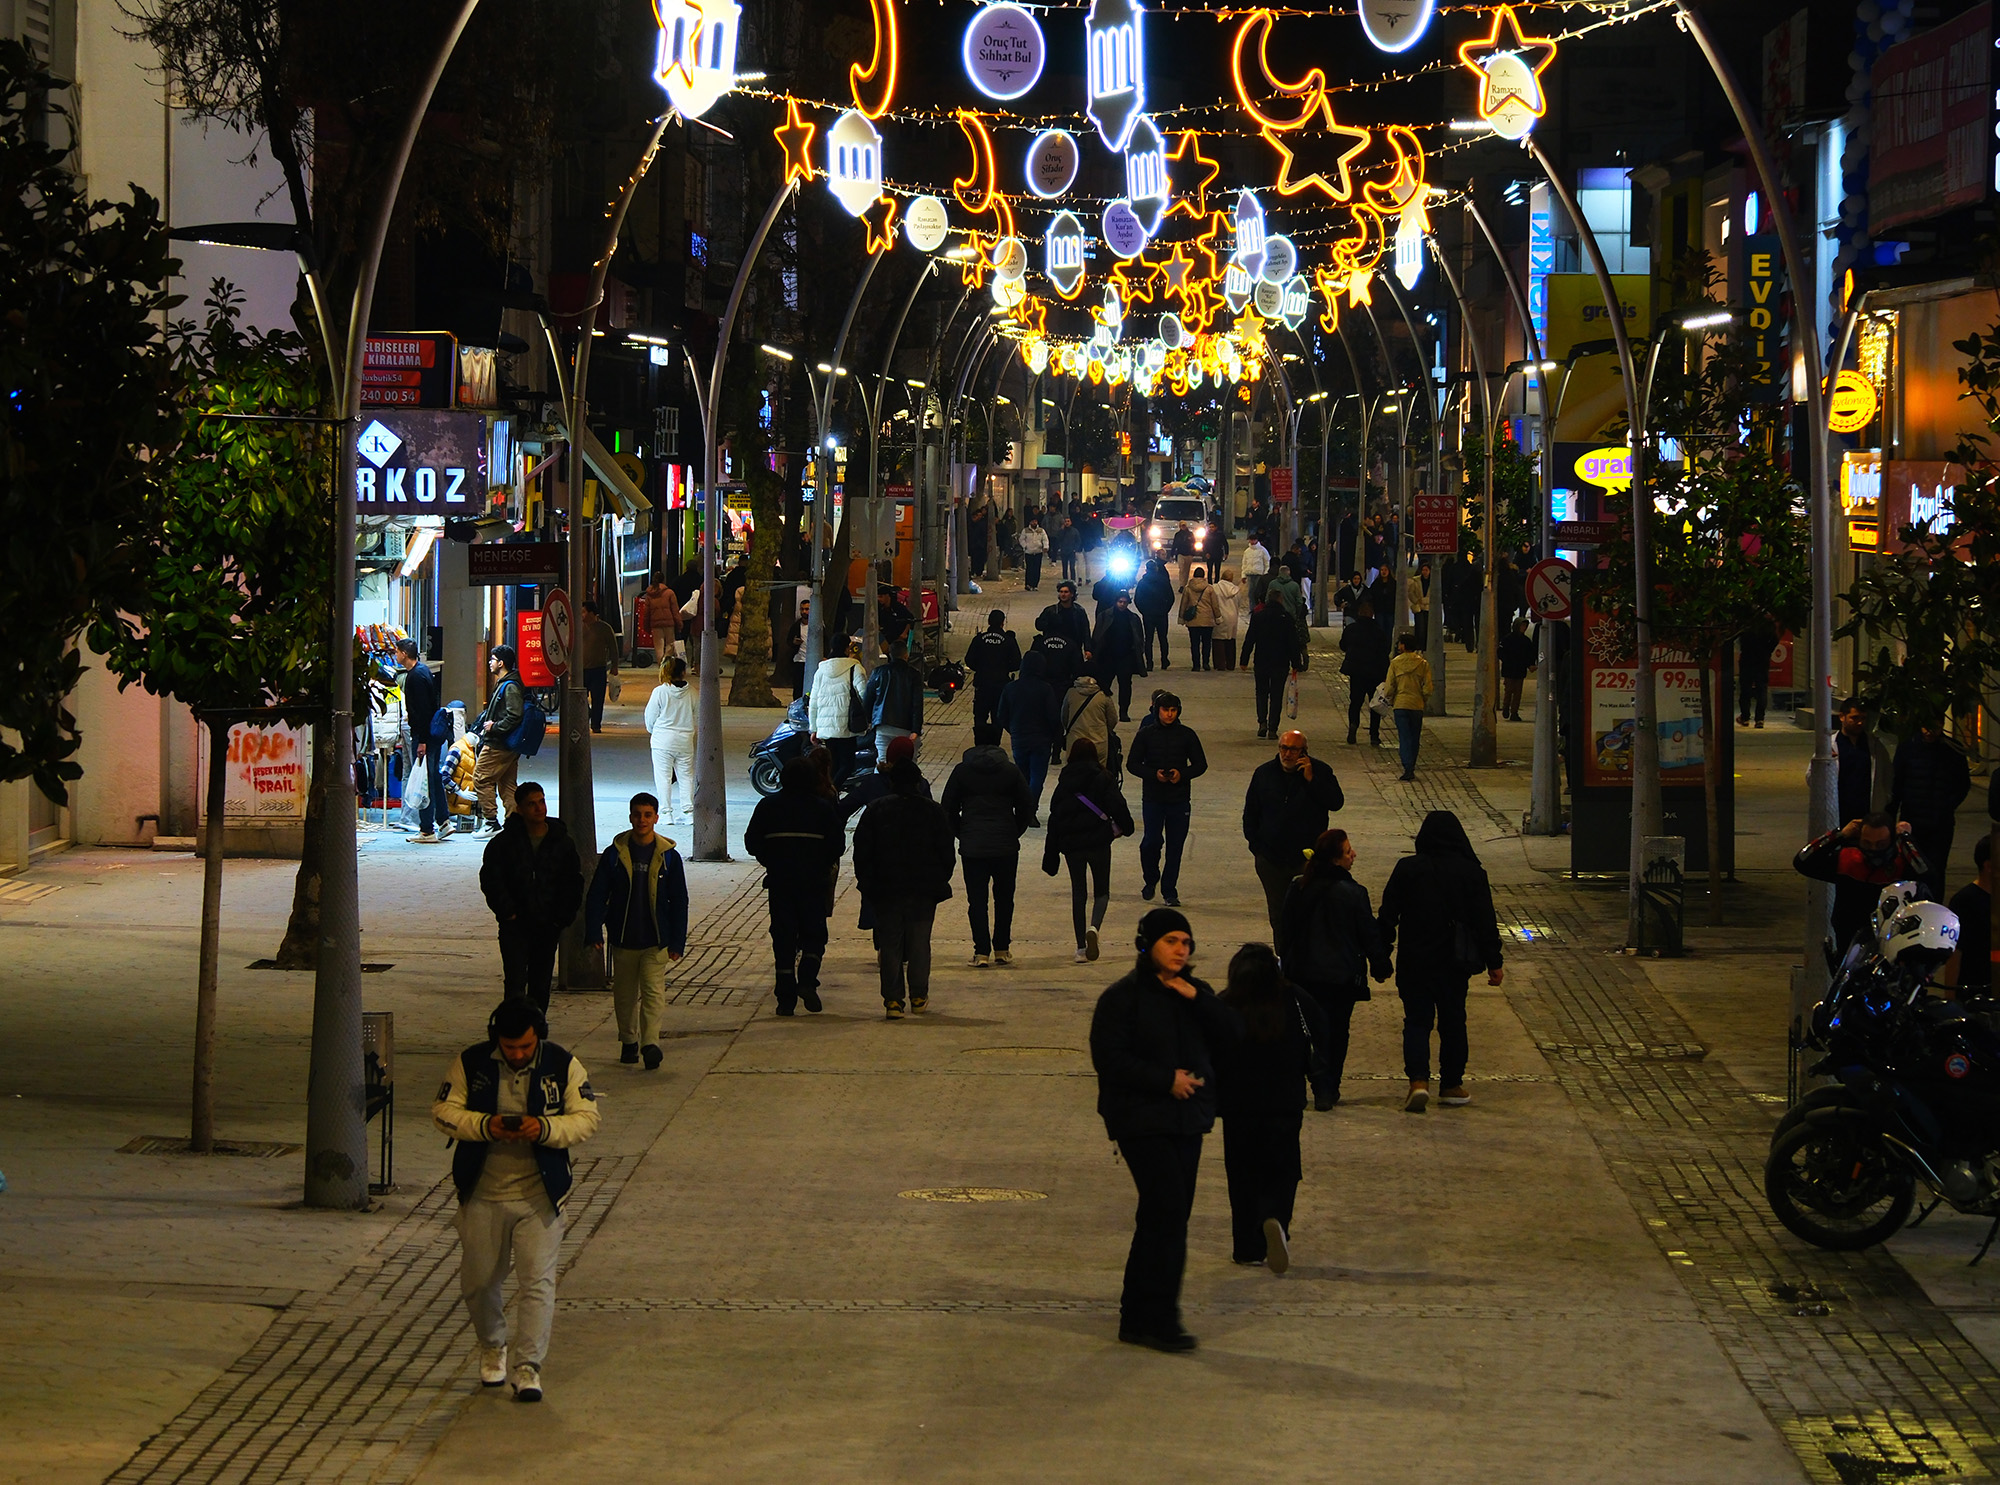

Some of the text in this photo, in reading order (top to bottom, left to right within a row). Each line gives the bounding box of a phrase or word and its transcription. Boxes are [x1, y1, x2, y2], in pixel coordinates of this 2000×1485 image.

[983, 35, 1027, 50] Oruç Tut
[979, 49, 1032, 63] Sıhhat Bul
[1583, 302, 1637, 323] grais
[365, 341, 419, 353] ELBİSELERİ
[368, 354, 421, 366] KİRALAMA
[384, 390, 398, 401] 00
[401, 391, 415, 401] 54
[474, 550, 532, 563] MENEKŞE
[1595, 671, 1636, 690] 229,9
